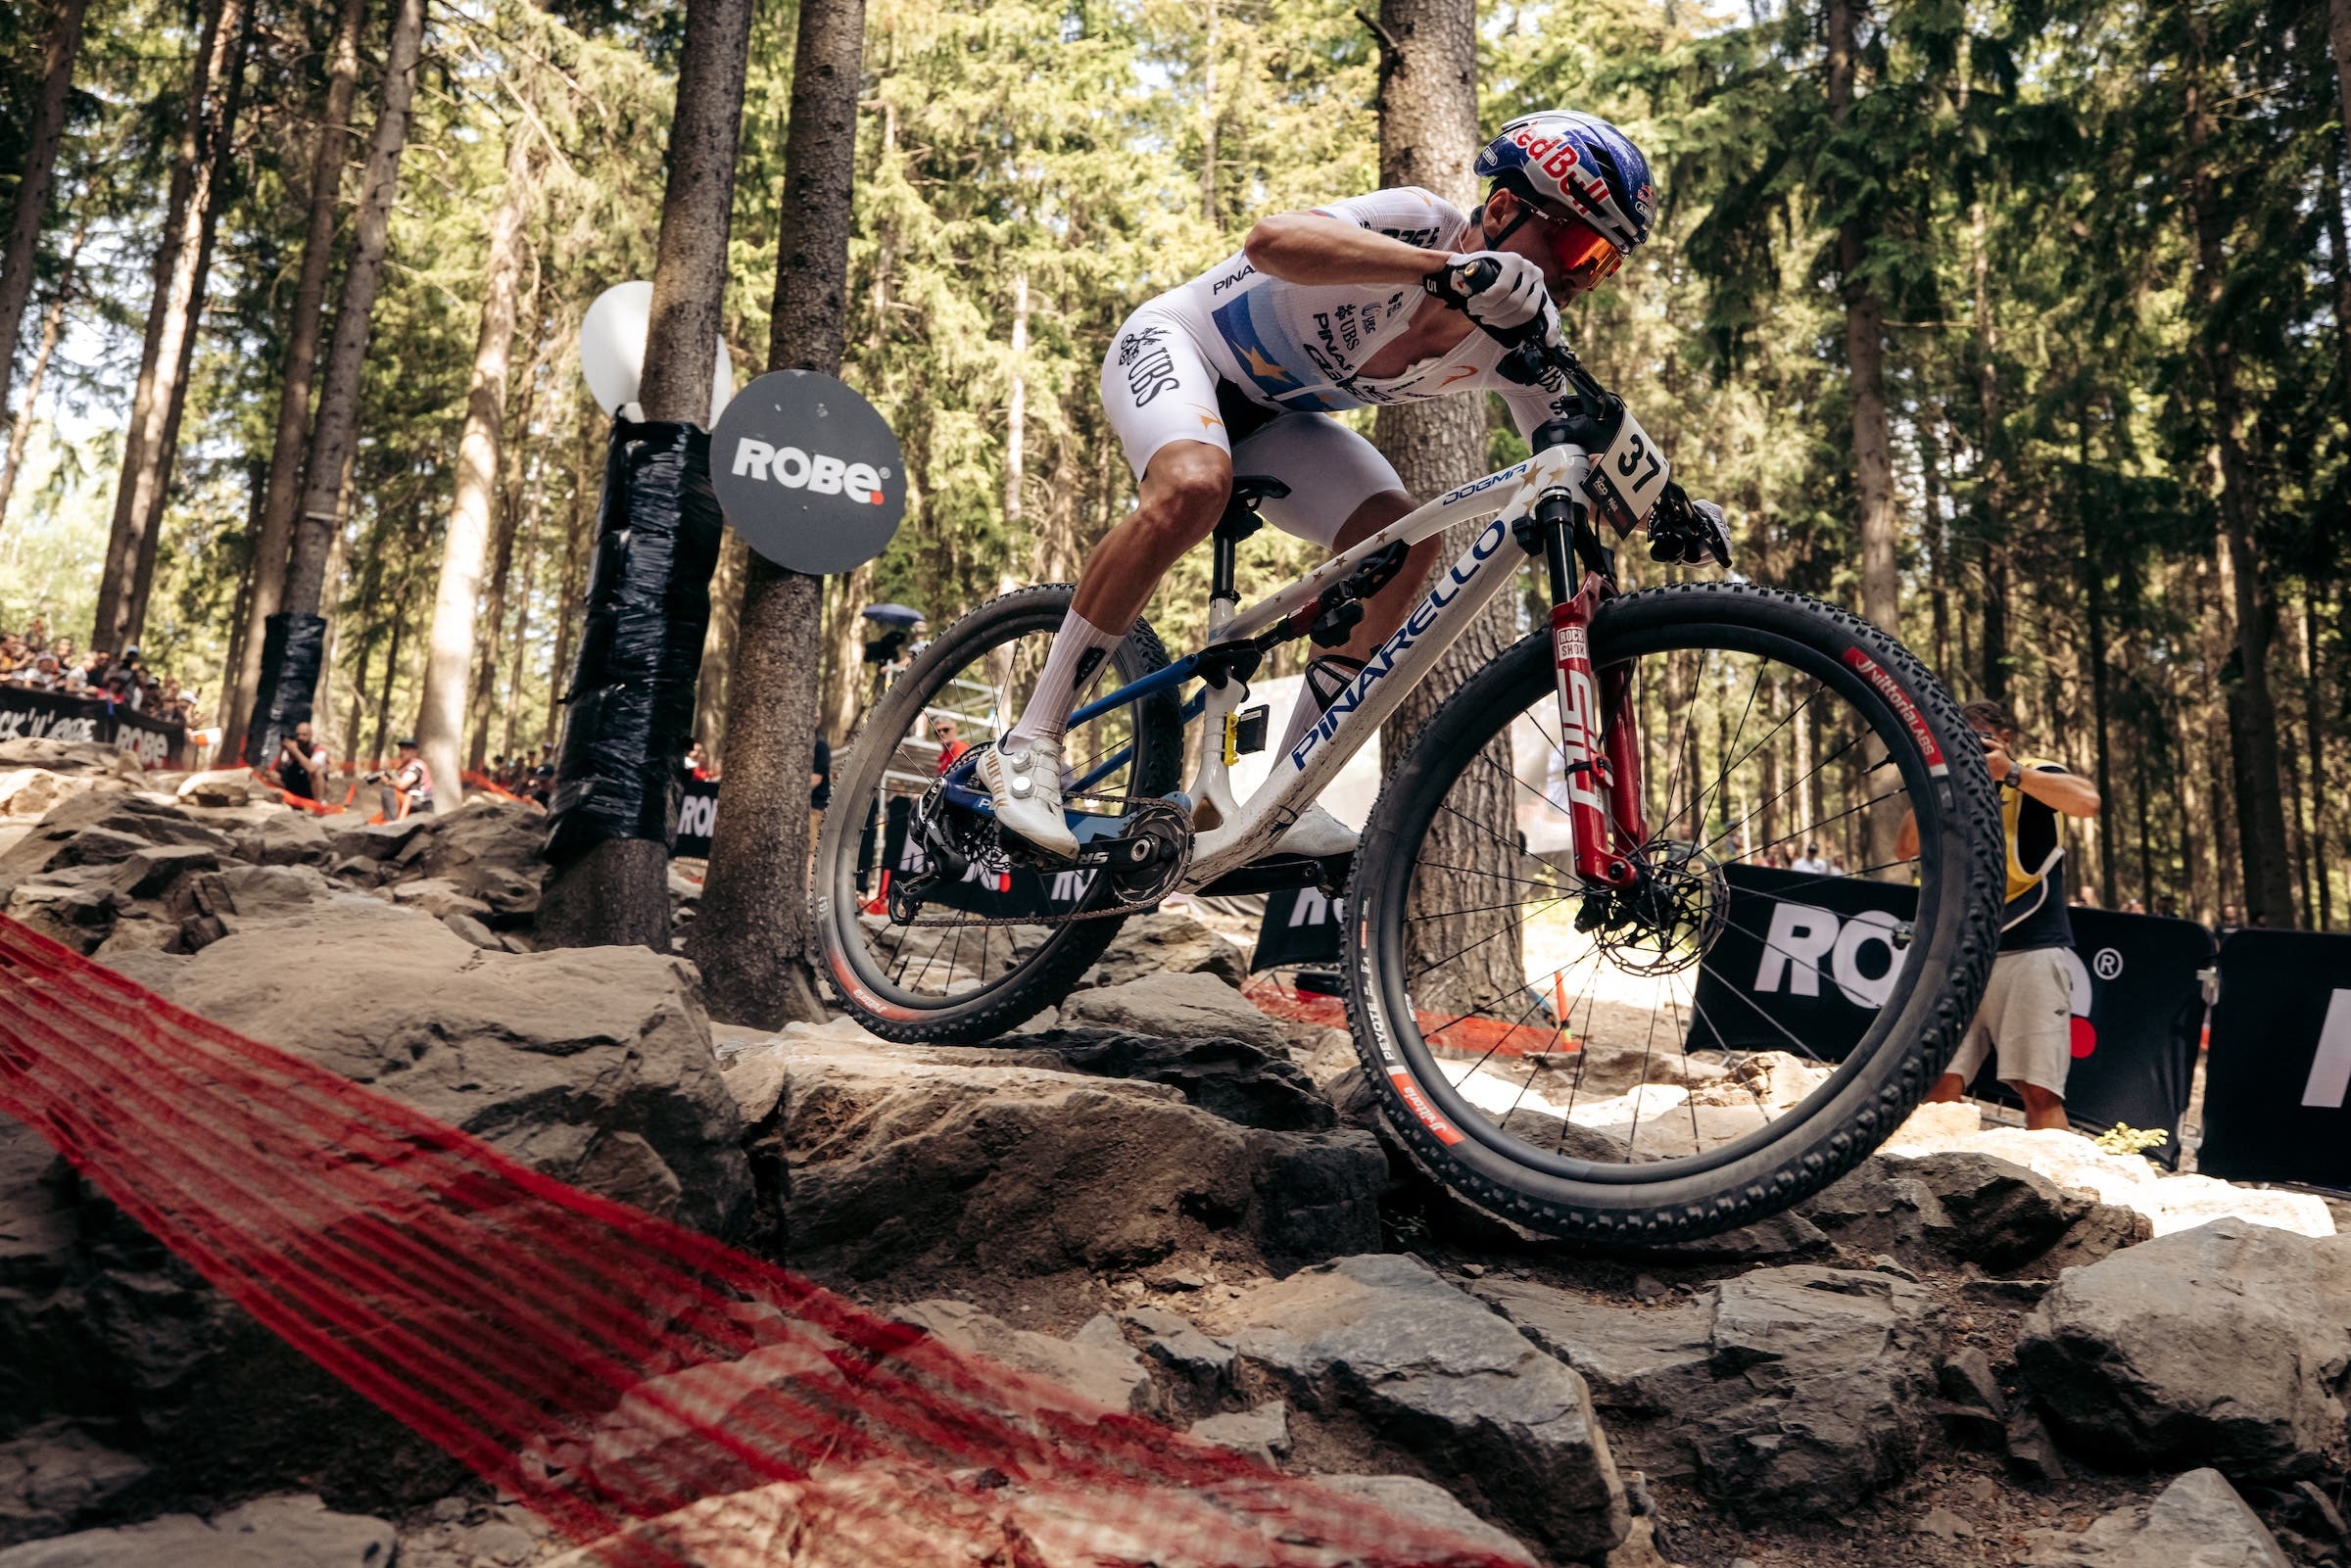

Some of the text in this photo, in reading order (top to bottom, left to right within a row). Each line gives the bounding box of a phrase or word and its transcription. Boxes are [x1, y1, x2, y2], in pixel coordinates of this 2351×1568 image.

[1340, 318, 1360, 351] UBS
[1128, 347, 1180, 407] UBS
[1442, 463, 1527, 506] DOGMA
[1617, 433, 1661, 494] 37
[1291, 520, 1506, 771] PINARELLO
[1559, 629, 1584, 644] ROCK
[1558, 668, 1613, 815] SID
[1367, 1003, 1395, 1061] PEYOTE
